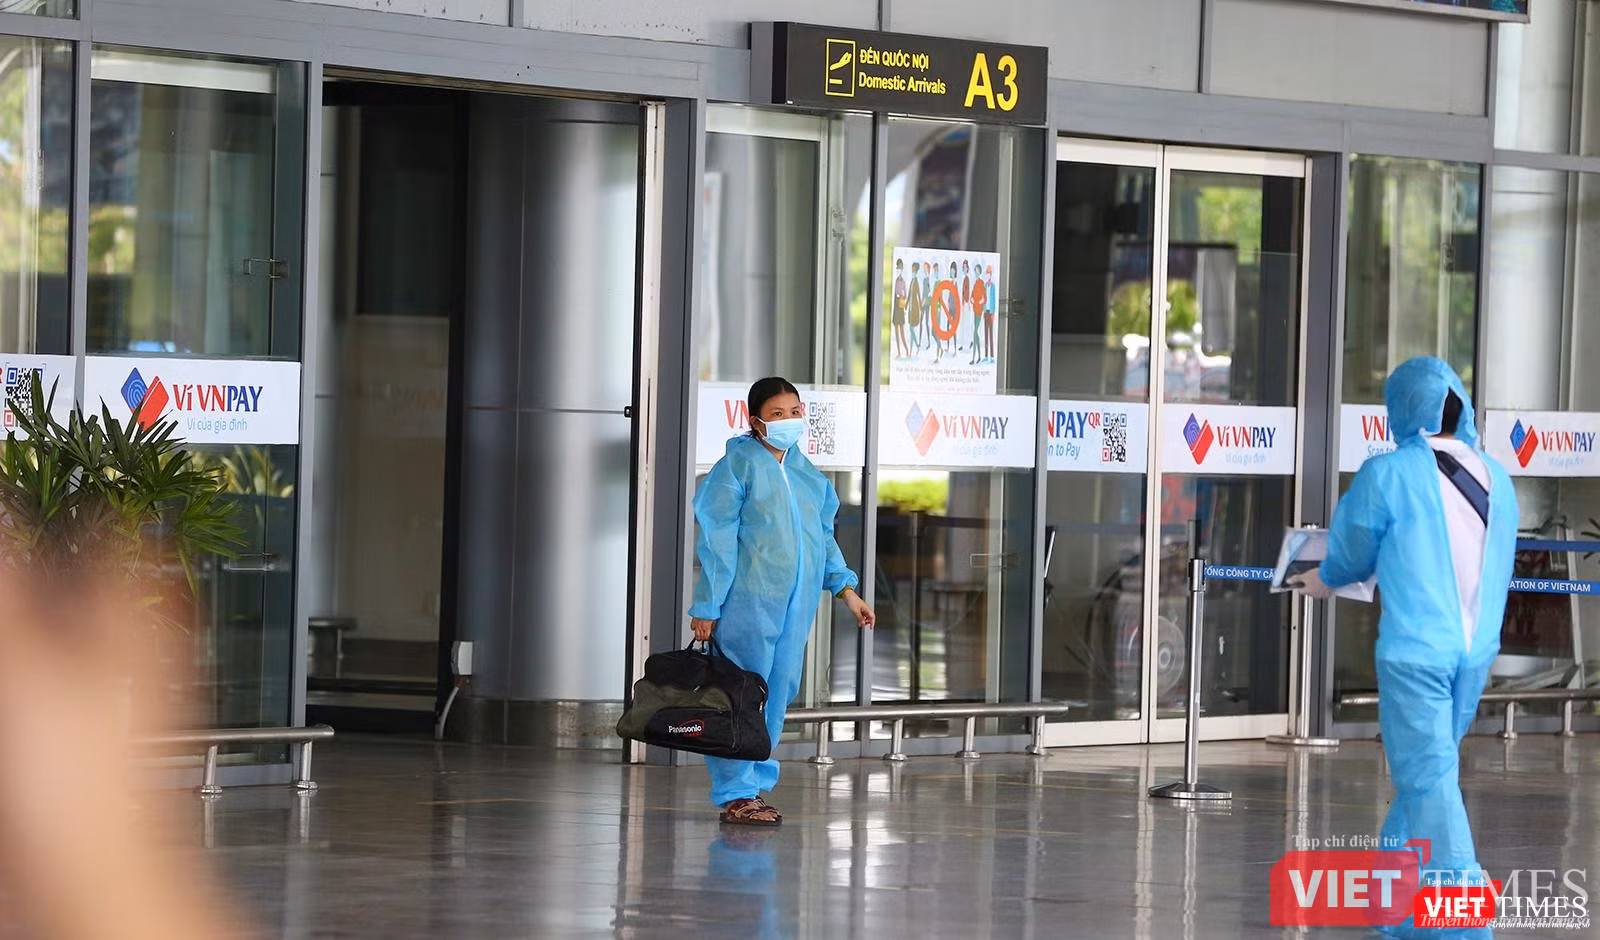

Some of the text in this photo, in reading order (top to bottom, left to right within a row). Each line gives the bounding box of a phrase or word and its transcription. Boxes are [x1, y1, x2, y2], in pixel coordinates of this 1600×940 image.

[859, 72, 946, 95] Domestic Arrivals
[963, 52, 1018, 111] A3
[172, 384, 263, 412] Ví VNPAY
[960, 415, 1009, 439] VNPAY
[1217, 426, 1276, 448] Ví VNPAY
[1056, 444, 1065, 456] to
[1066, 442, 1080, 461] Pay
[1555, 431, 1596, 452] VNPAY
[1250, 569, 1262, 578] TY
[1537, 581, 1549, 590] OF
[1551, 582, 1591, 592] VIETNAM
[668, 724, 702, 733] Panasonic
